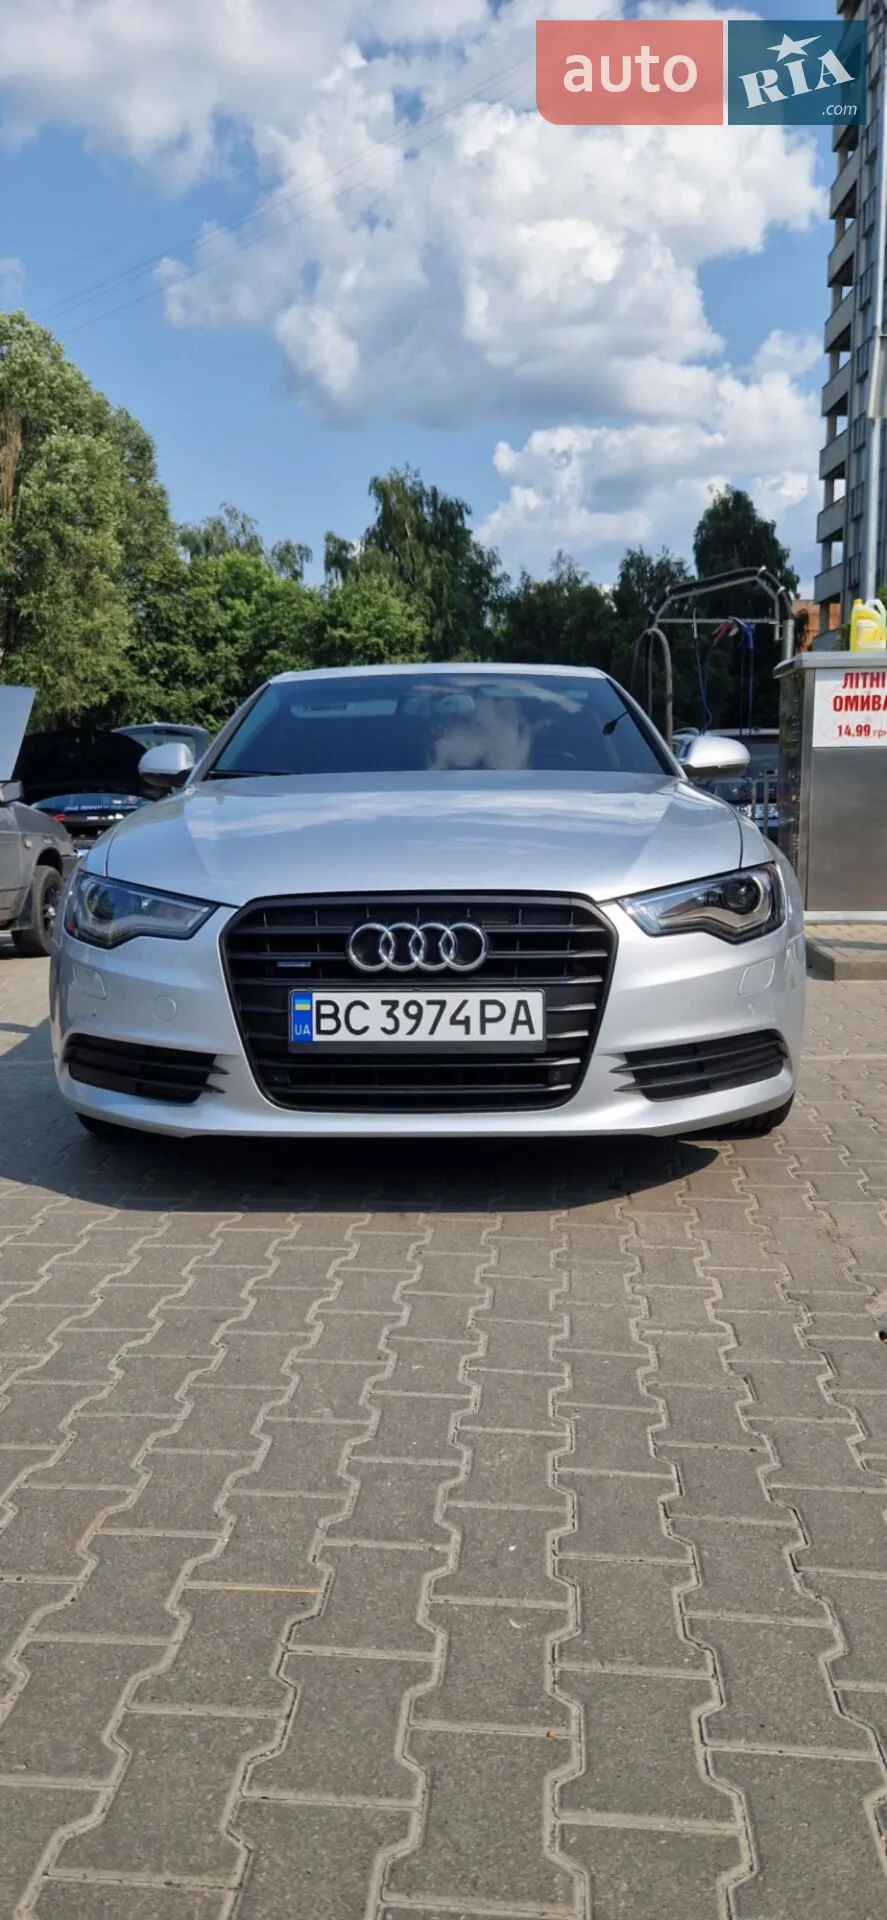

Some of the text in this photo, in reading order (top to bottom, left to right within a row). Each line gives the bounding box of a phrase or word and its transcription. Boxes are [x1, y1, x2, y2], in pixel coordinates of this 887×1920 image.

[842, 671, 886, 689] ЛІТНІ
[315, 999, 536, 1036] BC 3974 PA
[294, 1024, 311, 1036] UA
